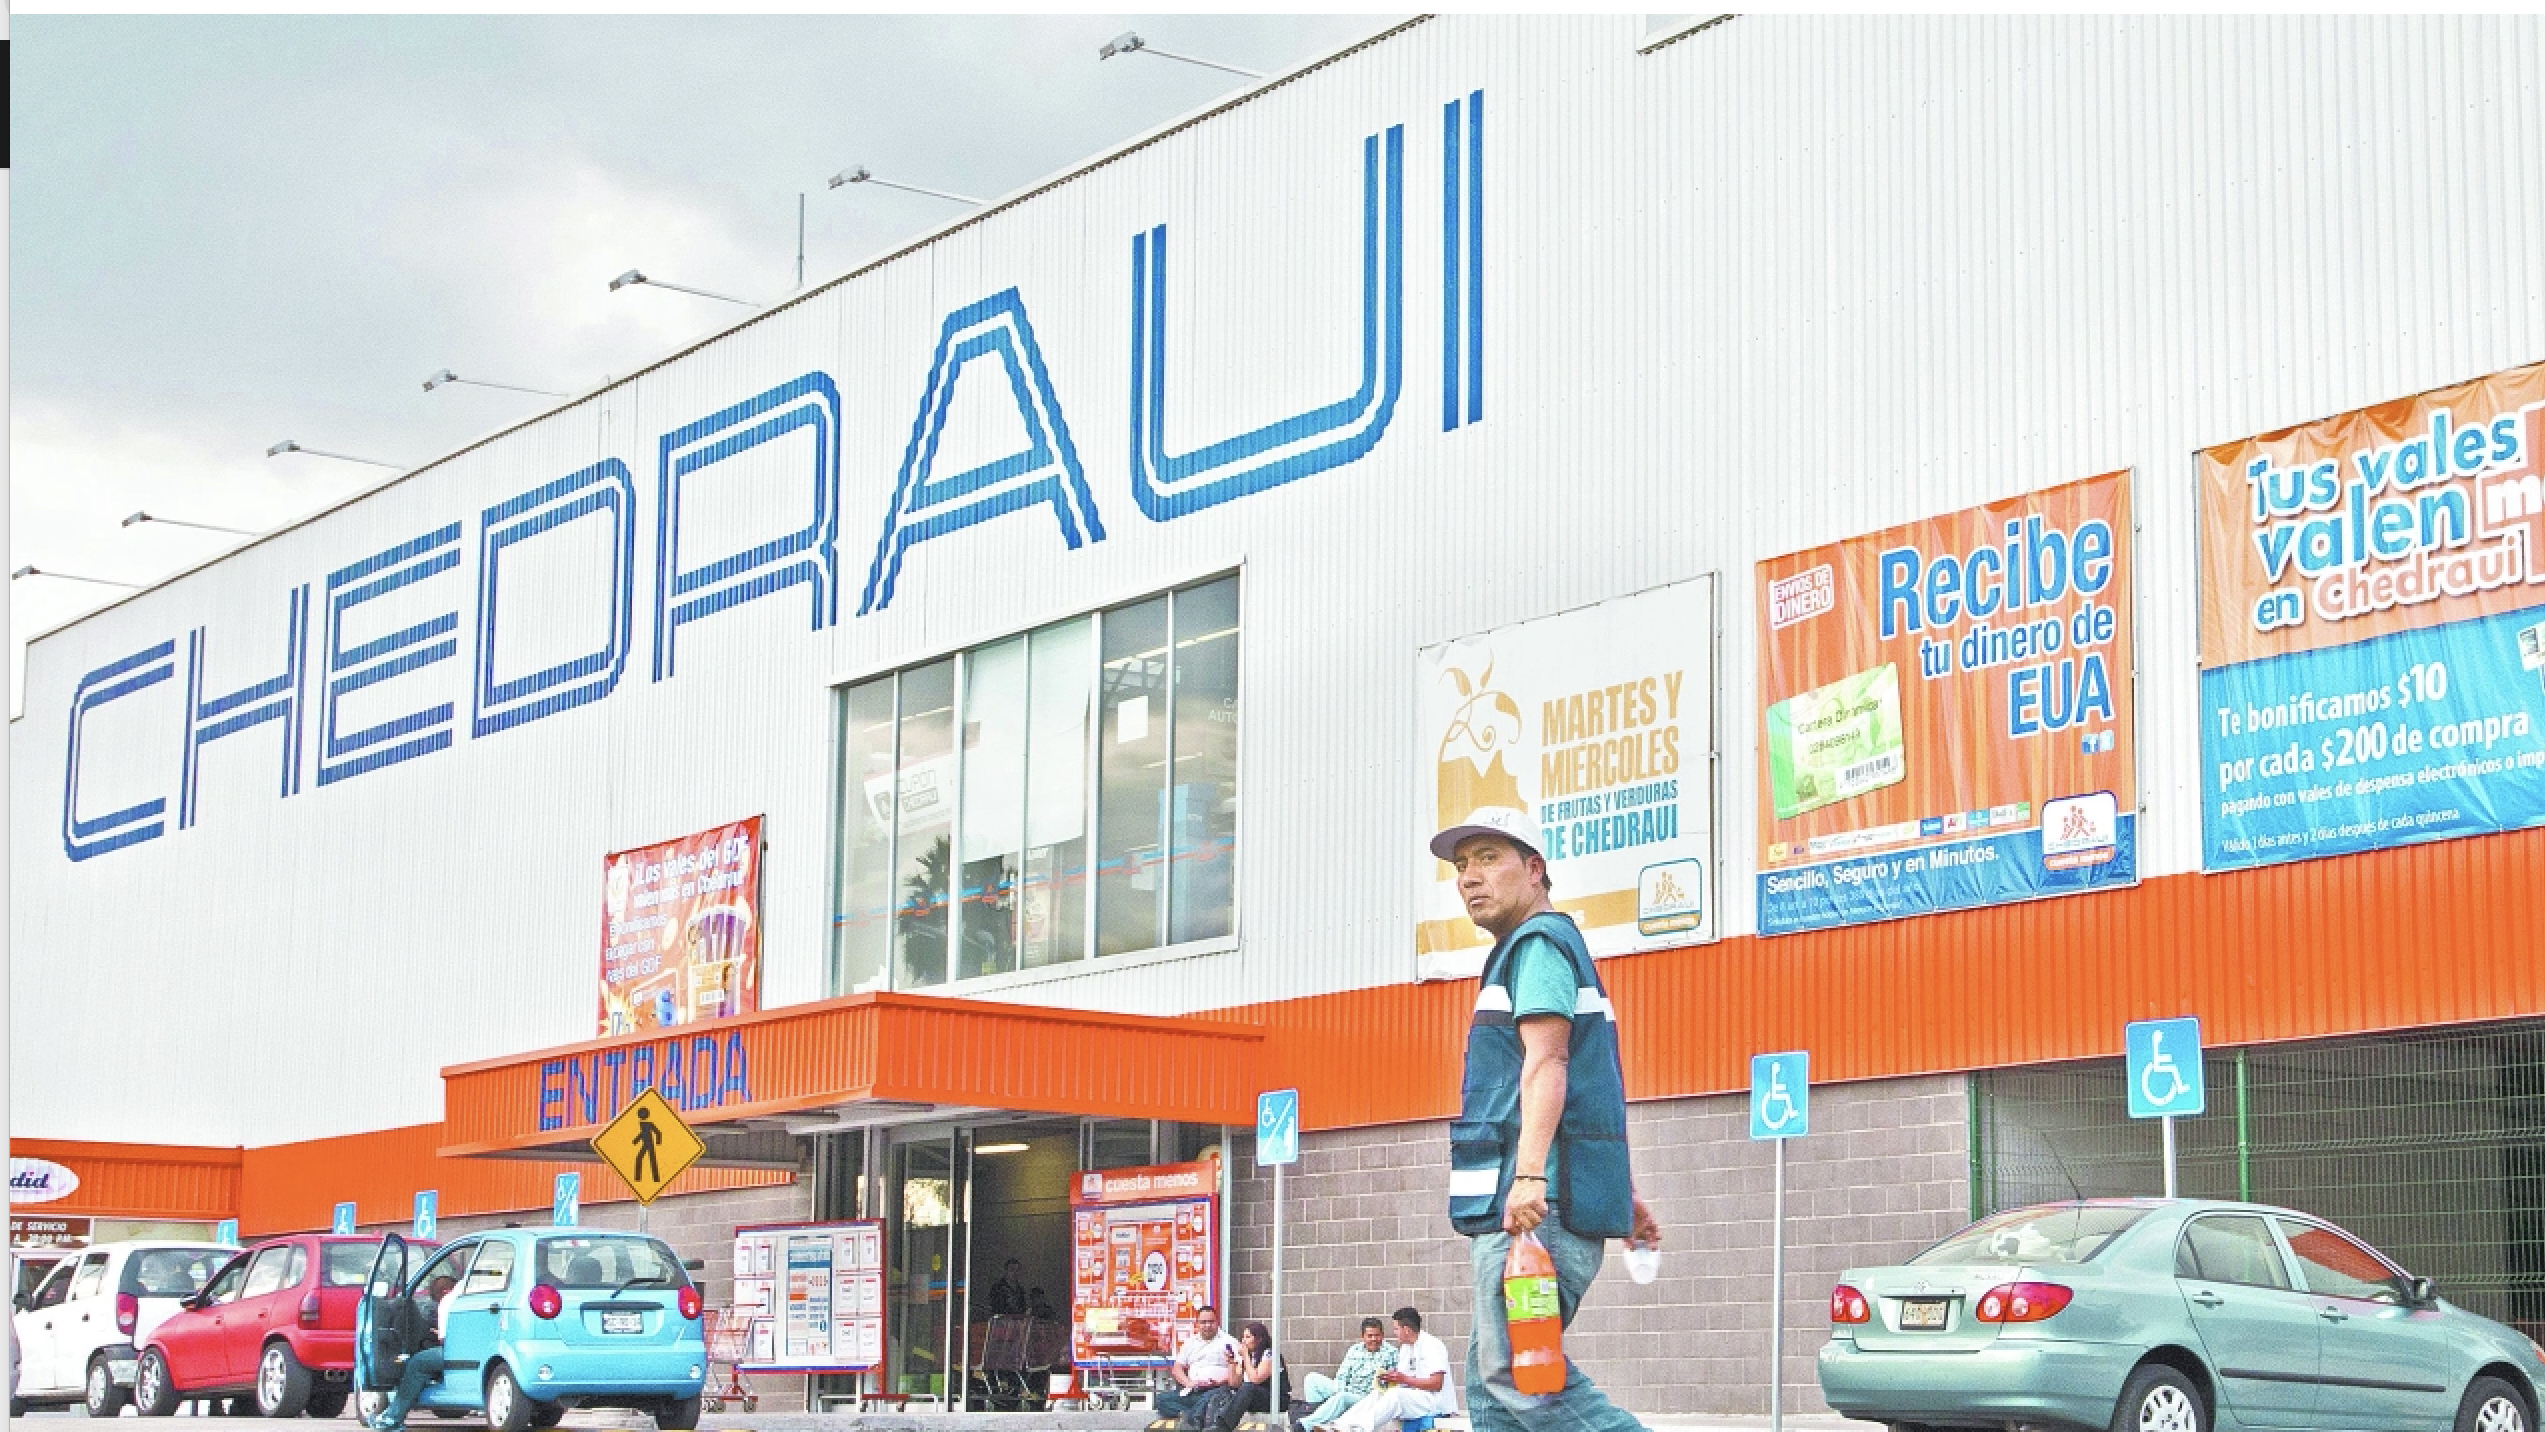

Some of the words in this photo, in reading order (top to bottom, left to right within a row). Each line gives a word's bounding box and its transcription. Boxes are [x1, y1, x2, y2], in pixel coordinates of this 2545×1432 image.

[62, 89, 1484, 862] CHEDRAUI
[2249, 459, 2338, 518] Tus
[2357, 413, 2519, 491] vales
[2257, 482, 2466, 578] valen
[1775, 586, 1831, 623] DINERO
[1815, 570, 1831, 587] DE
[1880, 515, 2113, 638] Recibe
[2256, 592, 2299, 625] en
[2317, 534, 2518, 613] Chedraui
[1921, 639, 1951, 678] tu
[1961, 618, 2063, 670] dinero
[2073, 602, 2114, 646] de
[1541, 675, 1657, 747] MARTES
[1663, 669, 1684, 720] Y
[2010, 654, 2113, 736] EUA
[2217, 706, 2242, 738] Te
[2246, 684, 2392, 734] bonificamos
[2397, 660, 2448, 709] $10
[2219, 757, 2255, 793] por
[2258, 741, 2315, 778] cada
[2320, 721, 2388, 773] $200
[2391, 723, 2423, 757] de
[2428, 709, 2530, 751] compra
[2220, 792, 2271, 819] pagando
[2272, 791, 2295, 807] con
[2297, 782, 2333, 803] vales
[2335, 779, 2352, 798] de
[2355, 770, 2416, 795] despensa
[2505, 754, 2515, 769] o
[1557, 794, 1602, 822] FRUTAS
[1603, 790, 1613, 813] Y
[1613, 778, 1679, 811] VERDURAS
[1571, 803, 1680, 858] CHEDRAUI
[699, 844, 719, 872] del
[1766, 870, 1829, 895] Sencillo,
[1832, 860, 1888, 887] Seguro
[1891, 857, 1902, 878] y
[1905, 853, 1925, 873] en
[1928, 844, 2000, 871] Minutos.
[538, 1030, 753, 1132] ENTRADA
[1105, 1174, 1151, 1192] cuesta
[1153, 1172, 1199, 1188] menos
